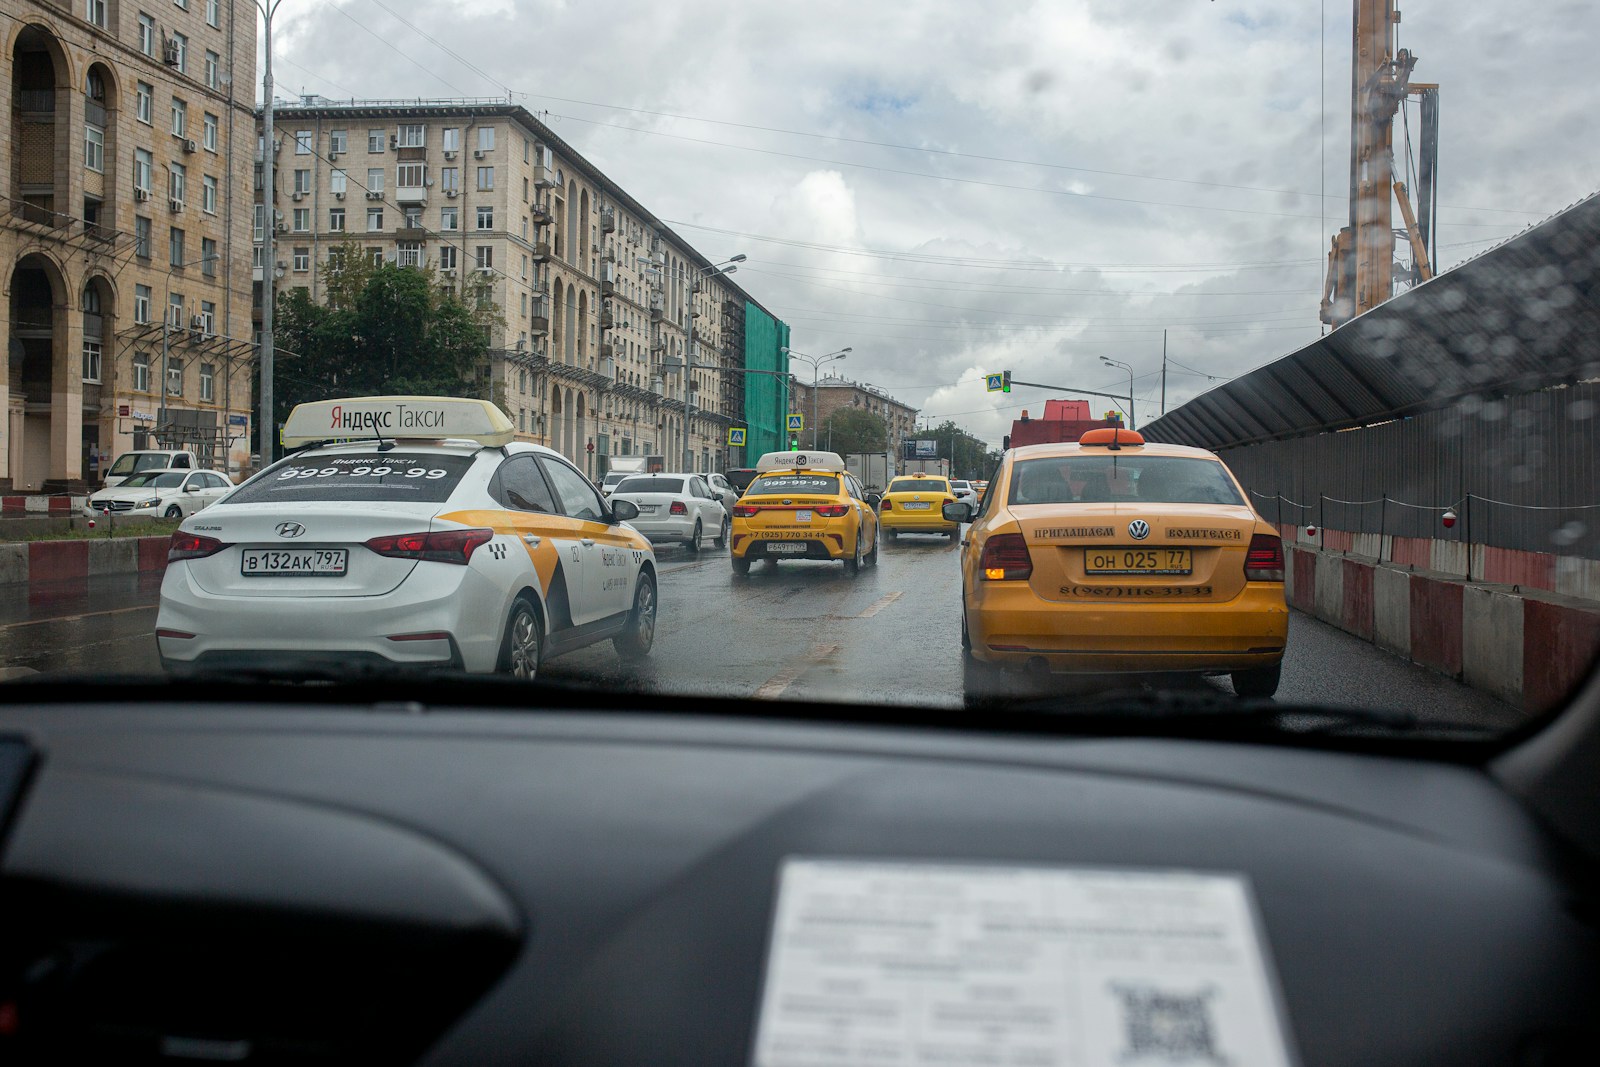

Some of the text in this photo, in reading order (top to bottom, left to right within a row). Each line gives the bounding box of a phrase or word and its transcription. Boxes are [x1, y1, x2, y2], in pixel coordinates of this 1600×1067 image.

[331, 404, 445, 430] Яндекс Такси
[381, 457, 417, 465] Такси
[775, 455, 824, 465] Яндекс Go Такси
[276, 466, 448, 481] 999-99-99
[1033, 527, 1115, 539] ПРИГЛАШАЕМ
[1168, 528, 1241, 540] ВОДИТЕЛЕЙ
[316, 551, 341, 565] 797
[1124, 552, 1157, 568] 025
[1167, 551, 1185, 563] 77
